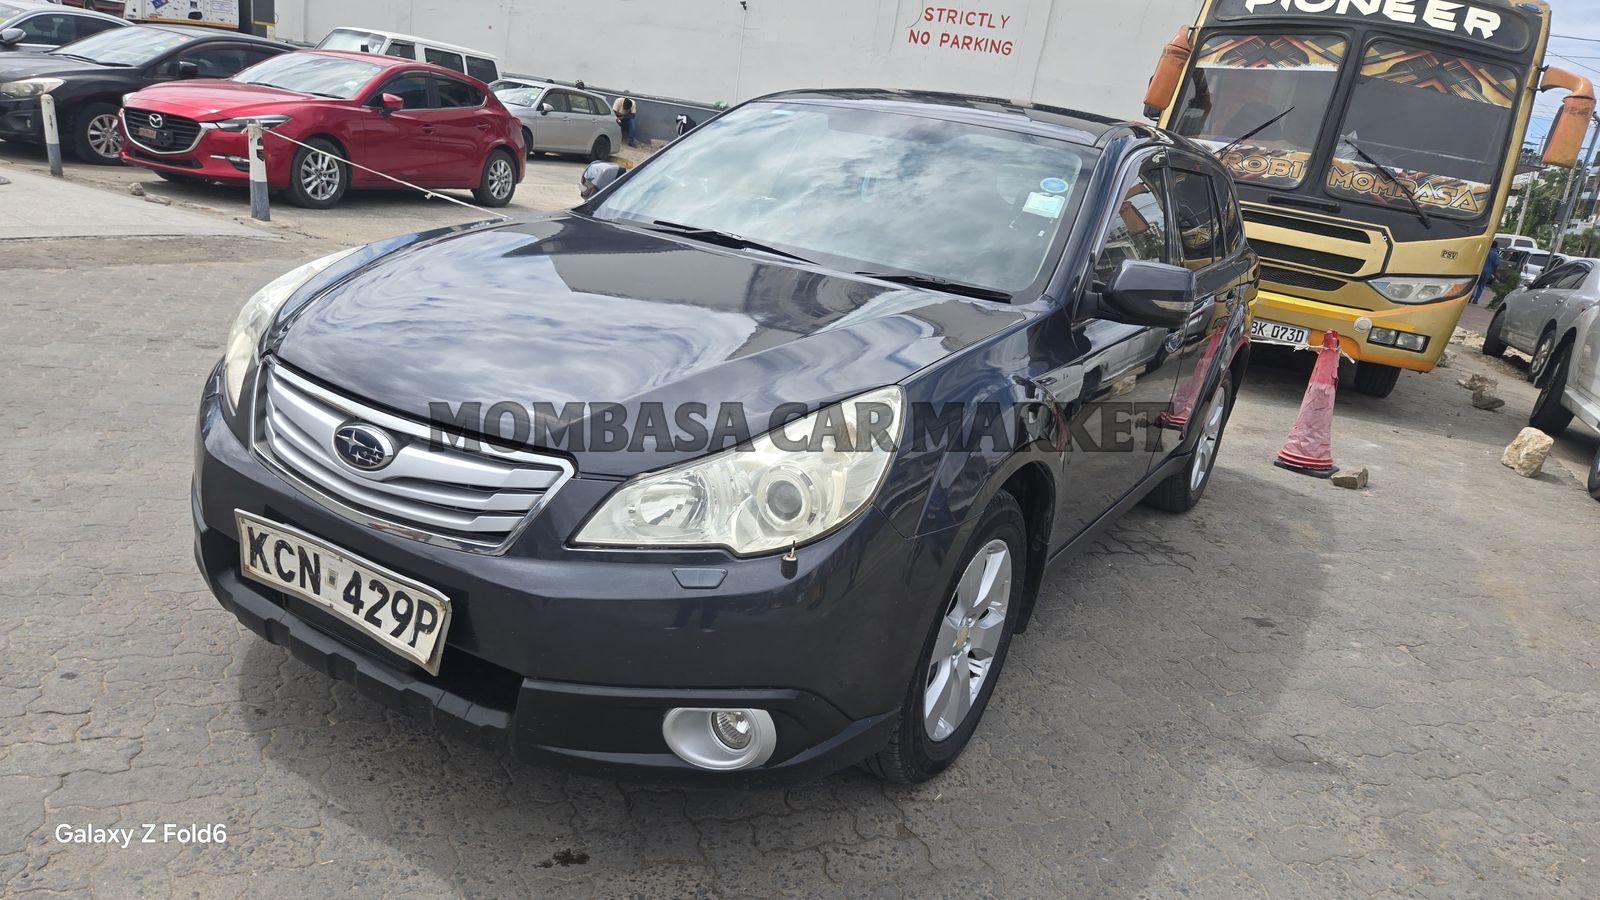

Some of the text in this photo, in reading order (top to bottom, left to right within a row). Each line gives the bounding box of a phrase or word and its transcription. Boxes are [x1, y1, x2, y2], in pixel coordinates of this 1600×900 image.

[924, 7, 1011, 29] STRICTLY
[908, 29, 1013, 56] NO PARKING
[1219, 152, 1305, 179] ROBI
[1440, 249, 1459, 260] PSV
[1251, 320, 1305, 343] BK 073D
[246, 525, 438, 649] KCN 429P
